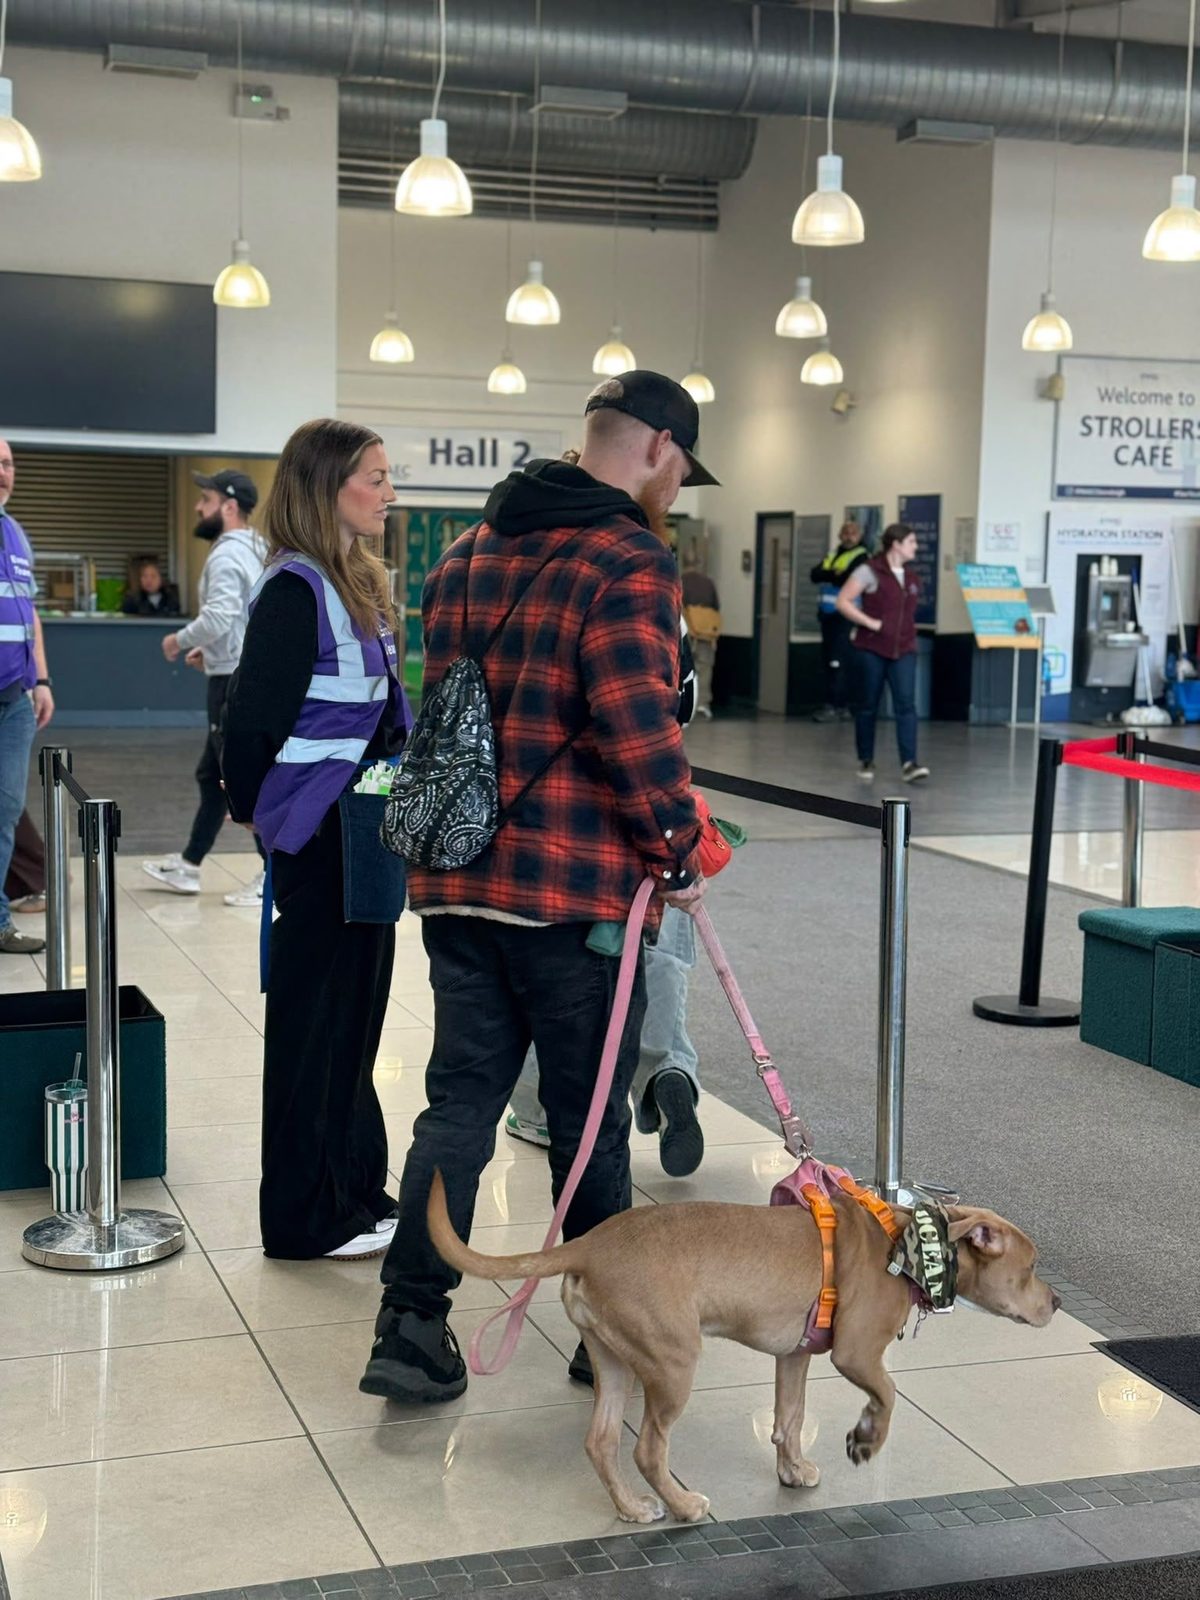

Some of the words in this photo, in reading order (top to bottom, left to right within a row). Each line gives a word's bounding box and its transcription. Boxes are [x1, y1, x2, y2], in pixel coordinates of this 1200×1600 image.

[1097, 386, 1173, 406] Welcome
[1178, 390, 1196, 407] to
[429, 437, 498, 467] Hall
[512, 441, 531, 468] 2
[1113, 444, 1174, 467] CAFE
[1057, 528, 1119, 539] HYDRATION
[1121, 529, 1164, 540] STATION
[915, 1210, 944, 1298] OCEAN
